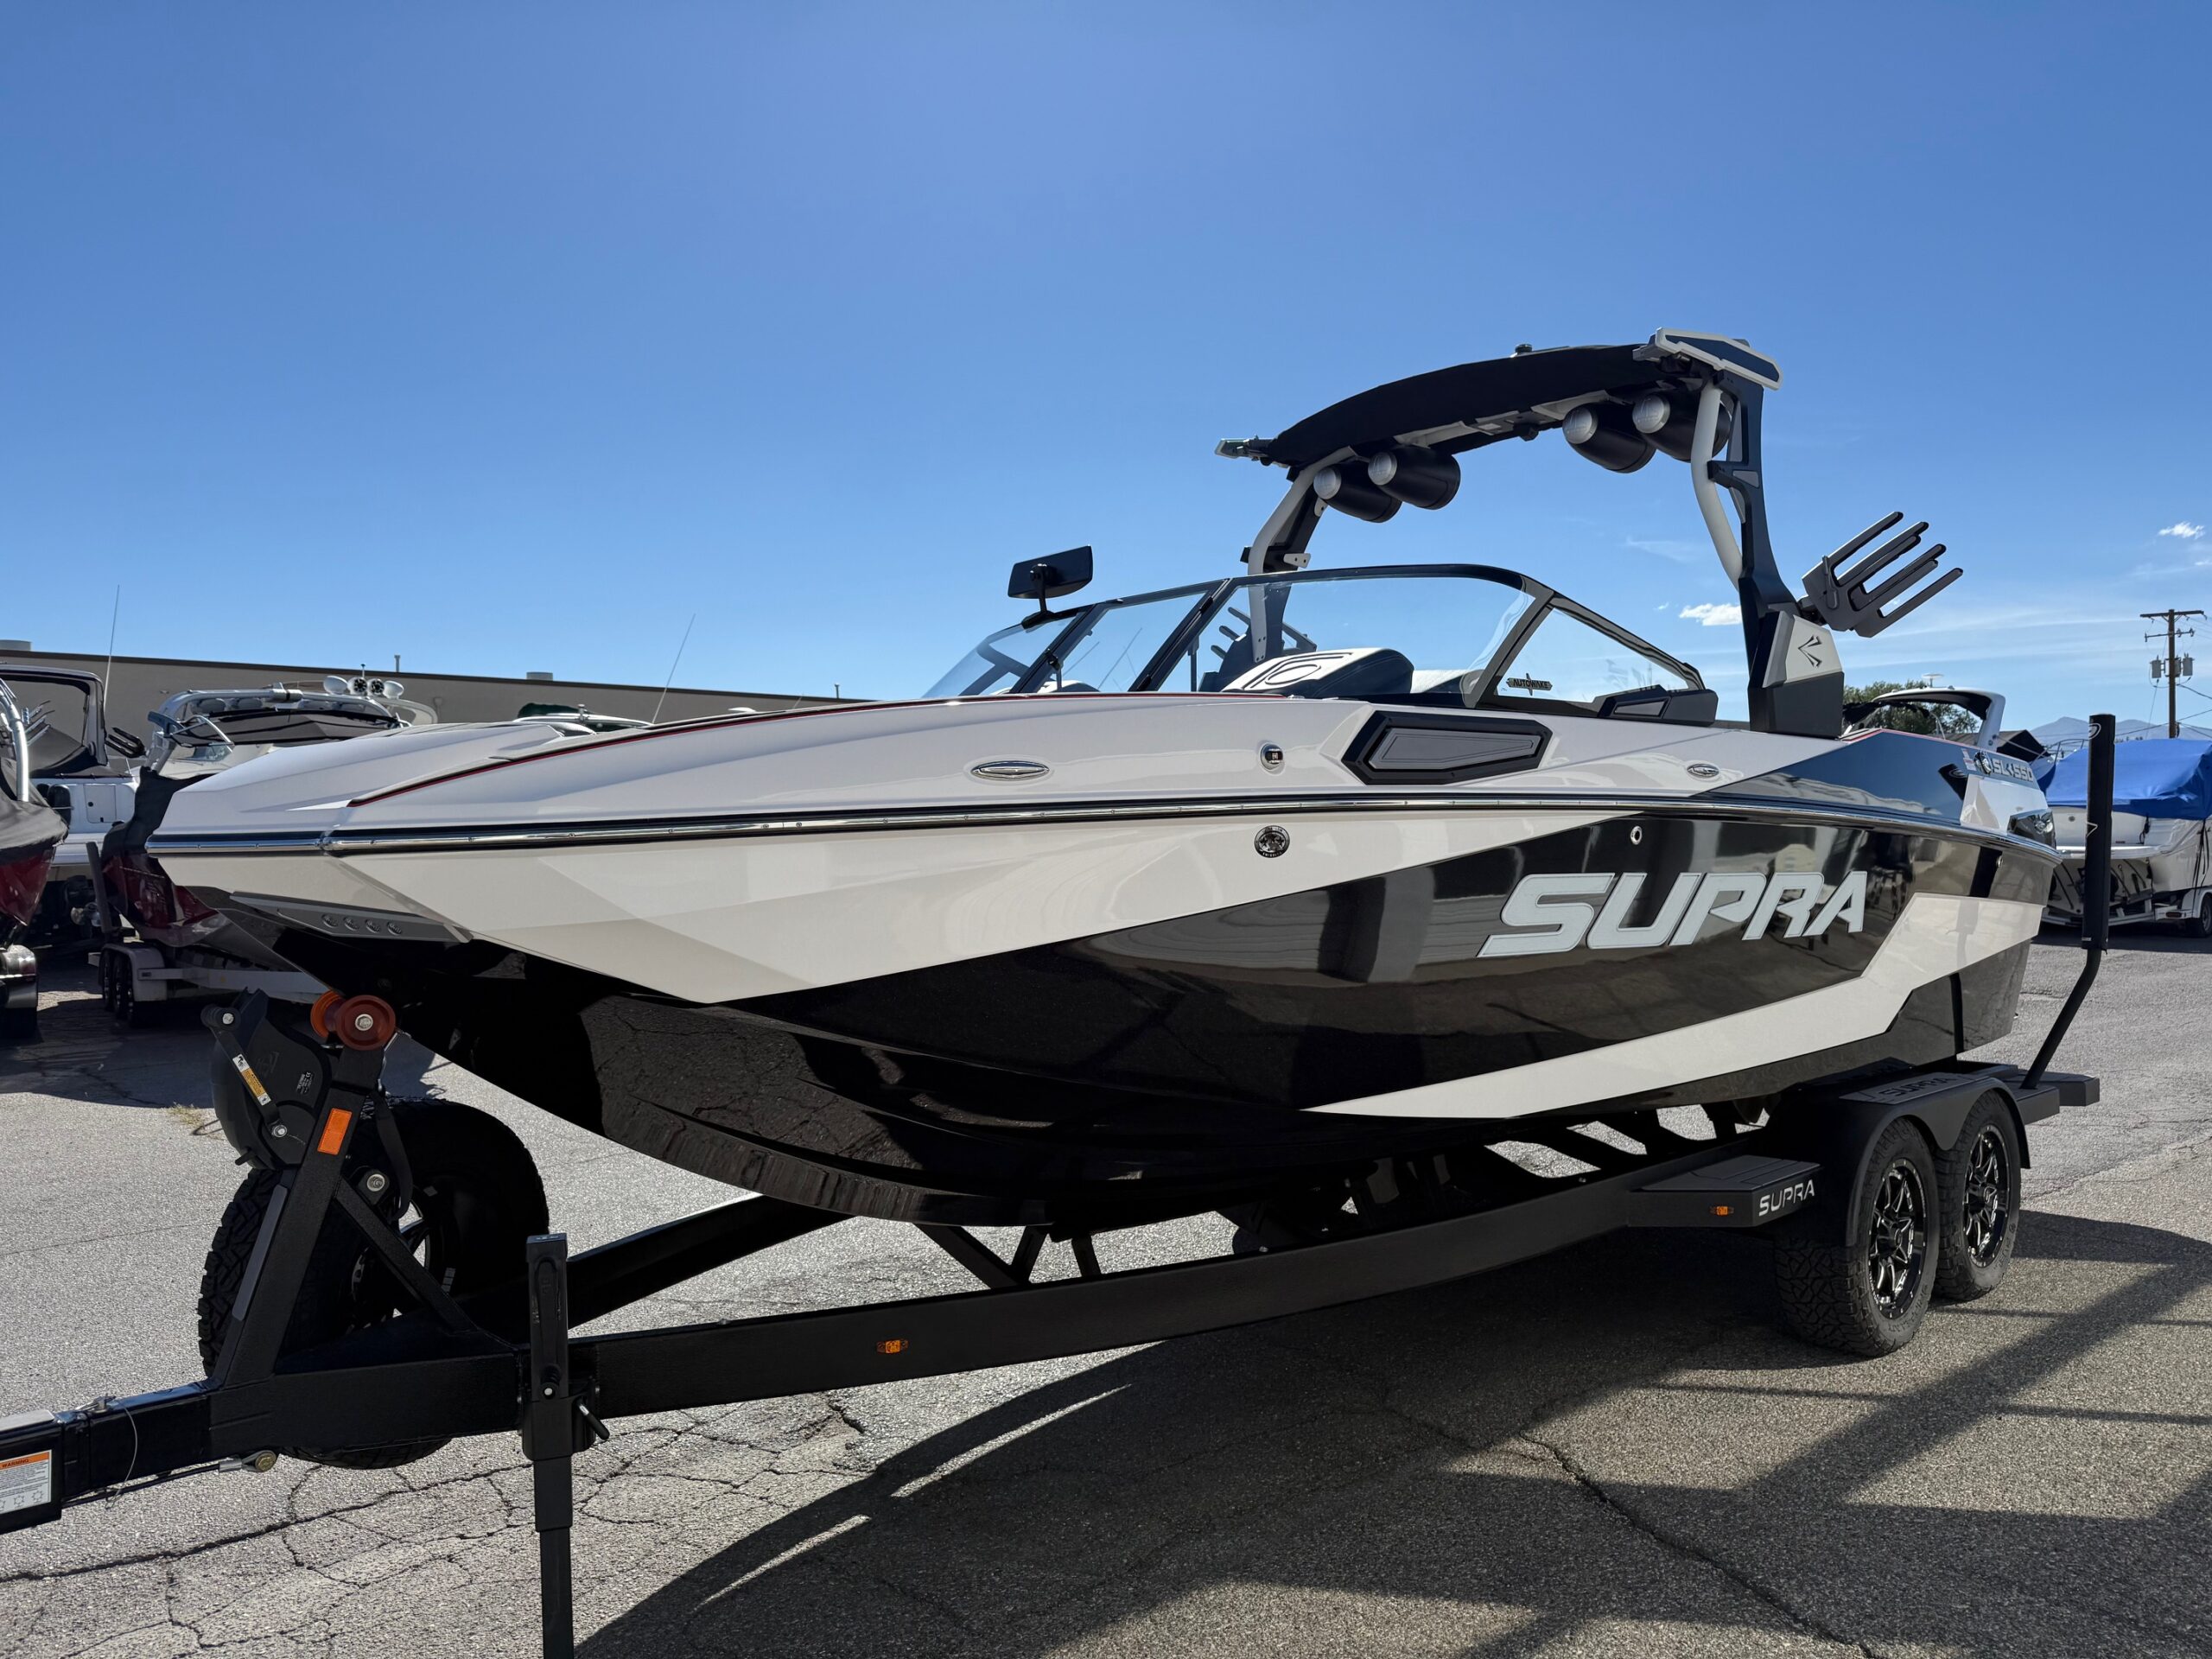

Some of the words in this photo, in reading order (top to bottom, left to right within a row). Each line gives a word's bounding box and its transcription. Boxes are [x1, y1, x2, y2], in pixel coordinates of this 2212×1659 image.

[1476, 871, 1868, 958] SUPRA
[1758, 1179, 1815, 1217] SUPRA
[2, 1458, 29, 1468] WARNING
